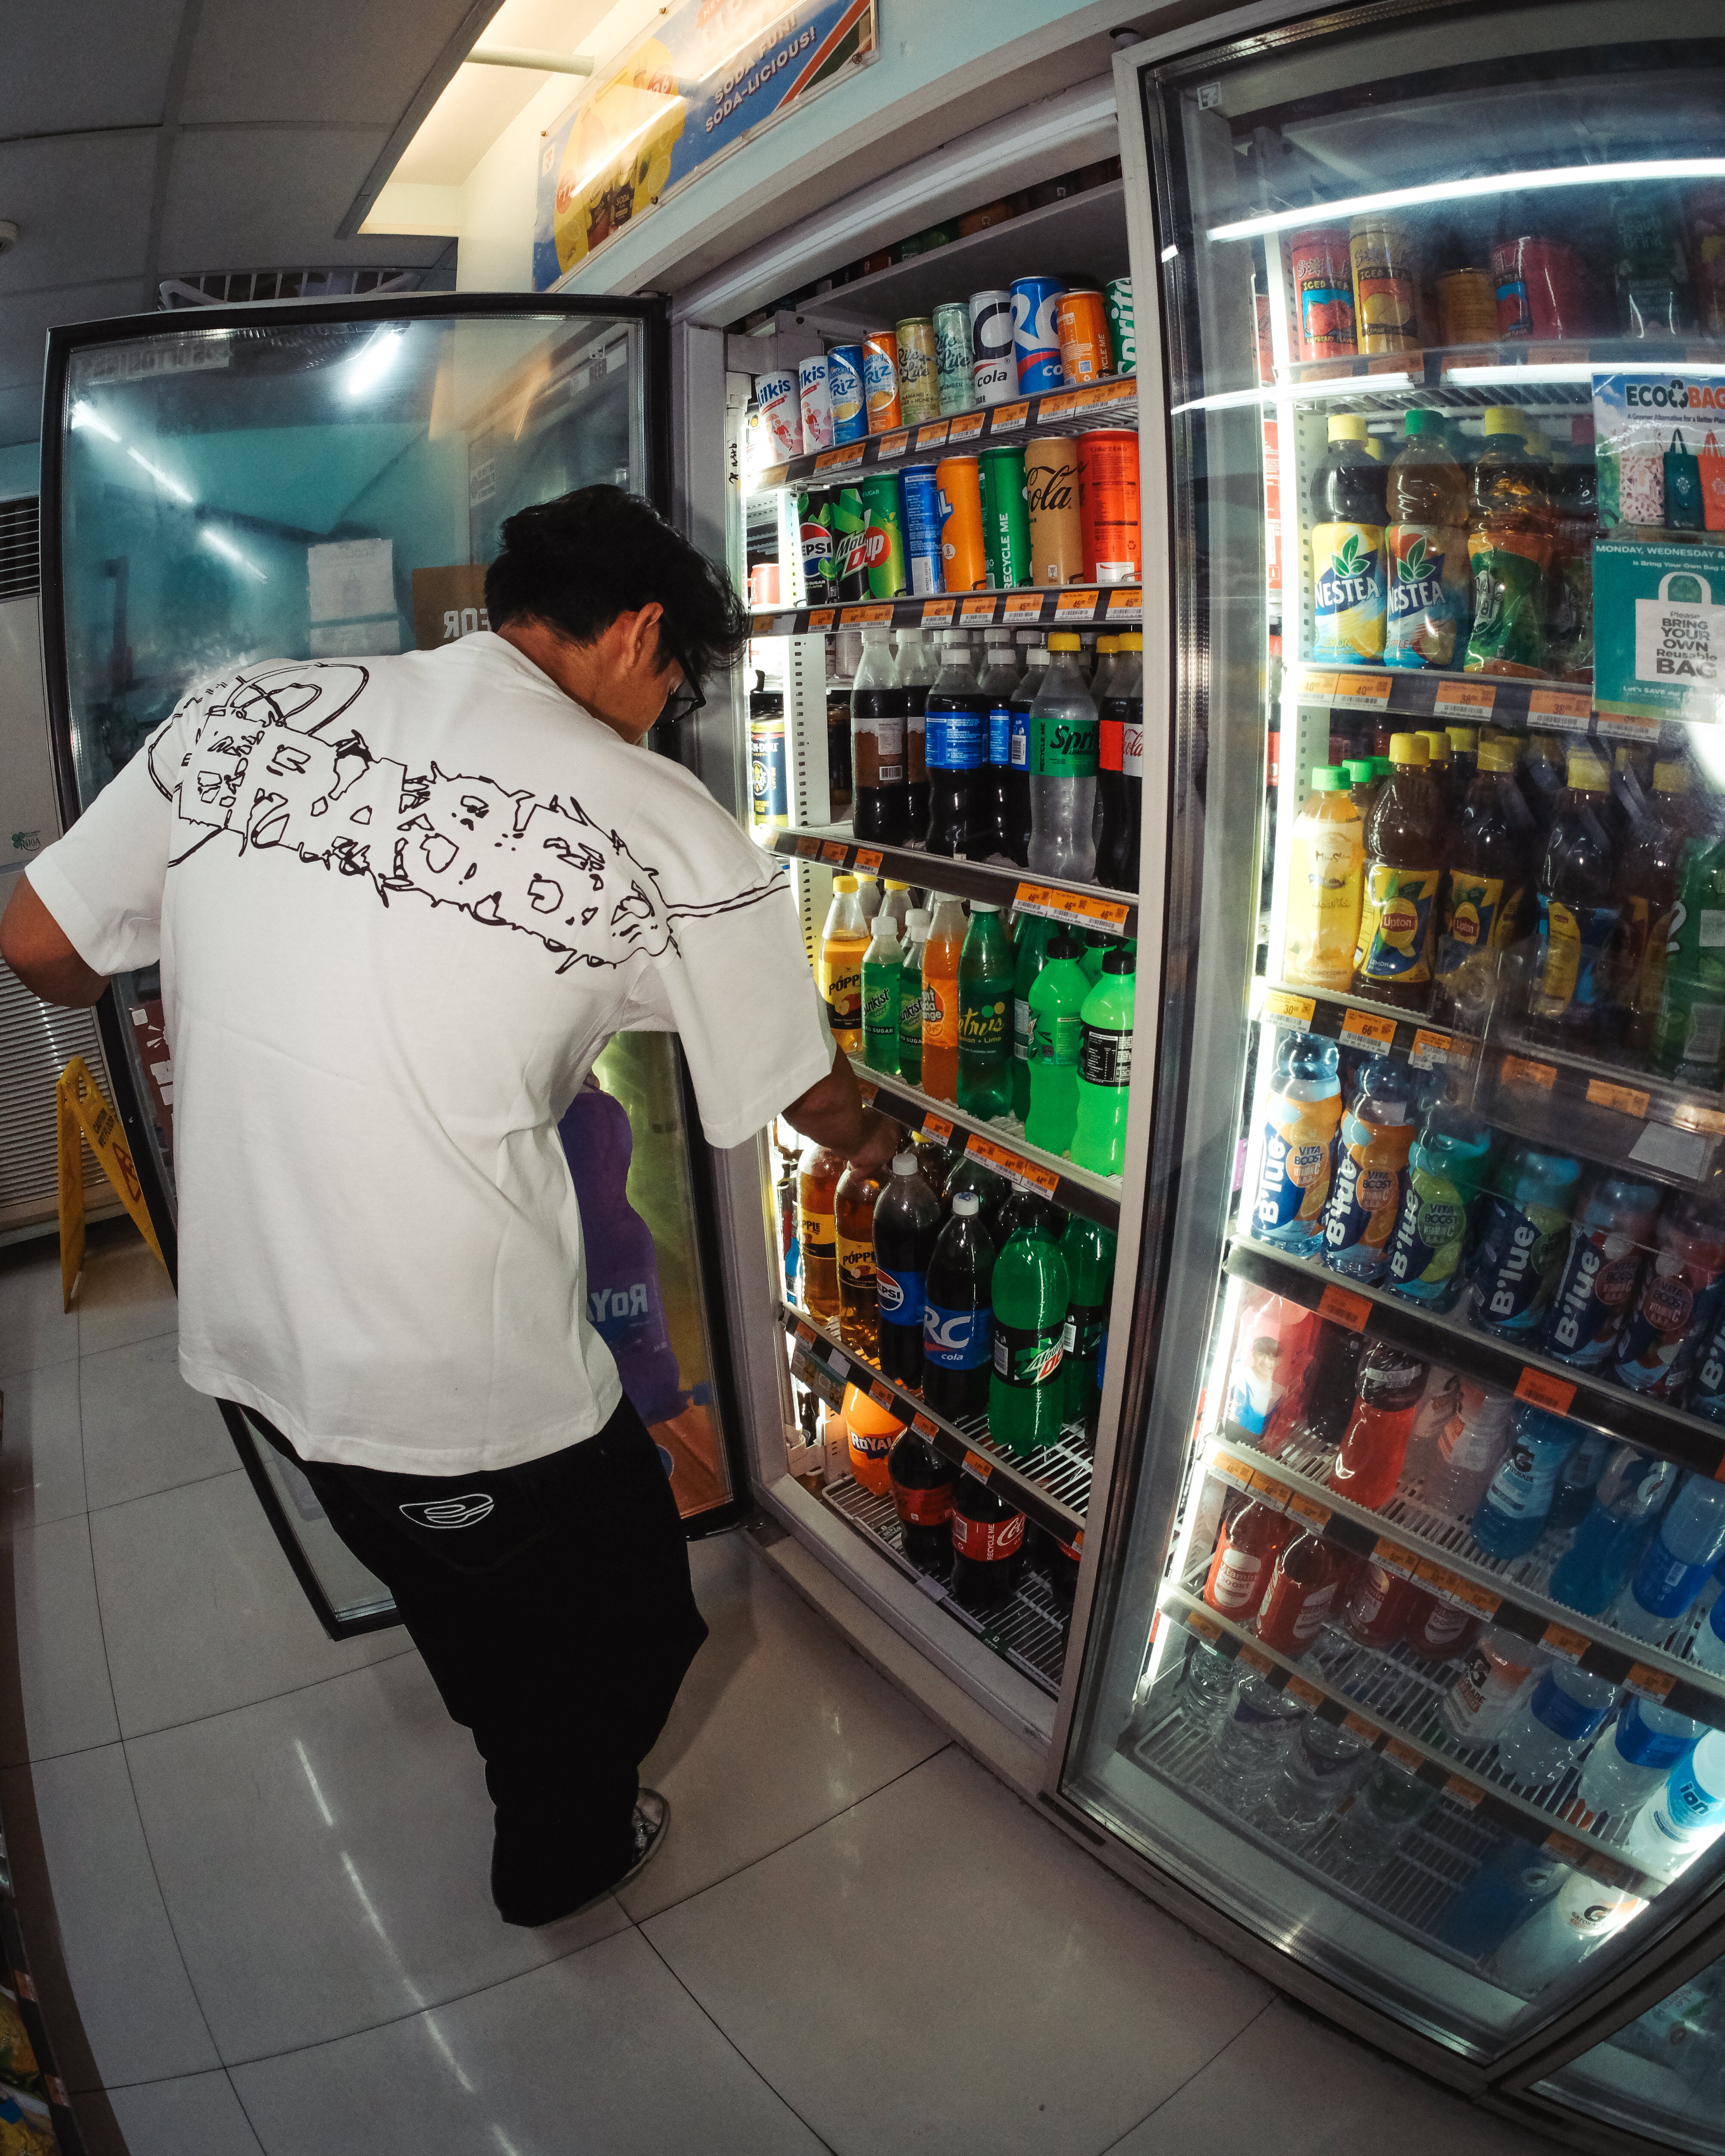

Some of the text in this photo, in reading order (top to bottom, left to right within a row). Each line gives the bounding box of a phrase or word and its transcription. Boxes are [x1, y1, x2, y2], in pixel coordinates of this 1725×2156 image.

[706, 26, 817, 133] SODA-LICIOUS!
[715, 59, 755, 105] SODA
[1303, 281, 1326, 291] ICED
[1099, 333, 1105, 346] ME
[1042, 365, 1063, 376] co
[977, 370, 1008, 388] cola
[1626, 385, 1668, 408] ECO
[999, 512, 1009, 533] ME
[1647, 548, 1714, 558] WEDNESDAY
[1314, 577, 1380, 609] NESTEA
[1387, 581, 1446, 614] NESTEA
[1662, 617, 1708, 630] BRING
[1661, 627, 1710, 641] YOUR
[1322, 638, 1353, 649] LEMON
[1662, 639, 1708, 652] OWN
[1656, 649, 1717, 661] Reusable
[1656, 658, 1717, 679] BAG
[1040, 722, 1046, 733] ME
[1383, 916, 1412, 929] Lipton
[1456, 919, 1474, 934] Lipton
[865, 988, 890, 1016] unkist
[900, 997, 922, 1023] unkist
[1298, 1145, 1321, 1156] VITA
[1294, 1153, 1325, 1166] BOOST
[1258, 1138, 1286, 1225] B'lue
[1326, 1158, 1357, 1246] B'lue
[1430, 1203, 1454, 1213] VITA
[1390, 1189, 1419, 1279] B'lue
[1489, 1226, 1535, 1316] B'lue
[1554, 1250, 1600, 1349] B'lue
[924, 1306, 971, 1348] RC
[941, 1353, 963, 1361] cola
[988, 1524, 995, 1533] ME
[1680, 1781, 1709, 1815] ion
